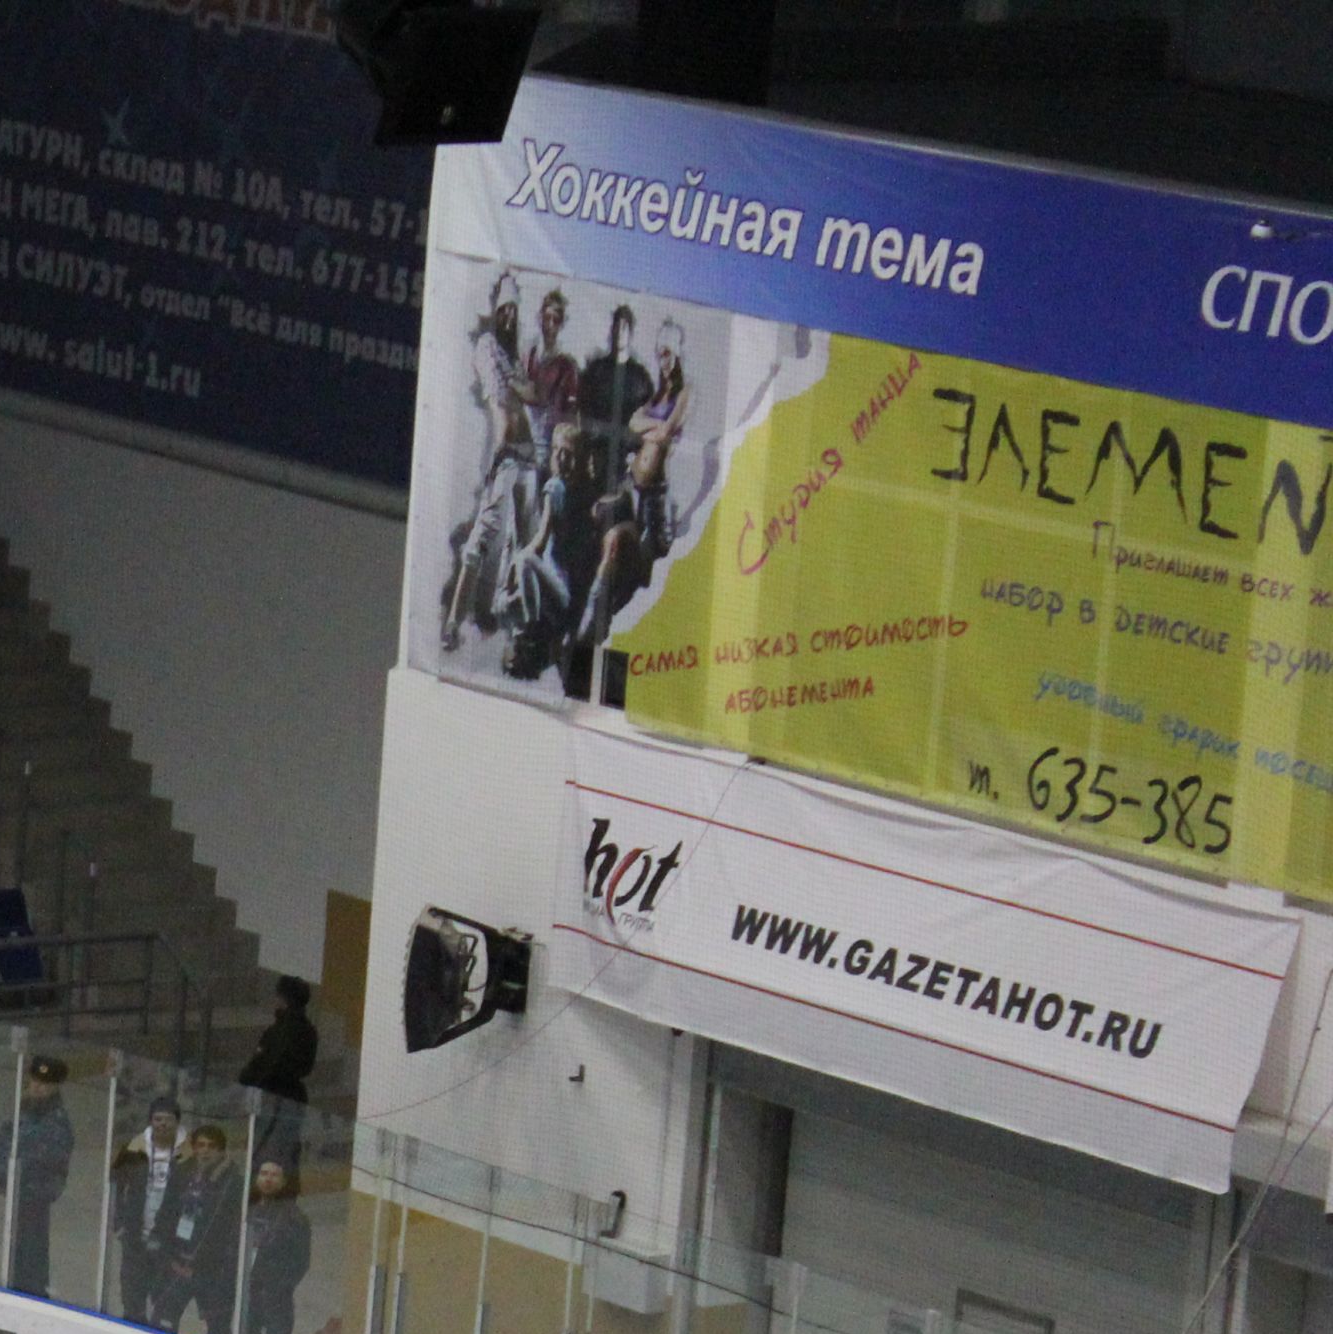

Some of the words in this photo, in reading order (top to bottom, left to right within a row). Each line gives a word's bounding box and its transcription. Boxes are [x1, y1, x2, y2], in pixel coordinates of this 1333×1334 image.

[98, 147, 184, 192] склад
[506, 138, 803, 260] Хоккейная
[816, 216, 984, 296] тема
[1027, 746, 1233, 855] 635-385
[730, 904, 1163, 1061] WWW.GAZETAHOT.RU
